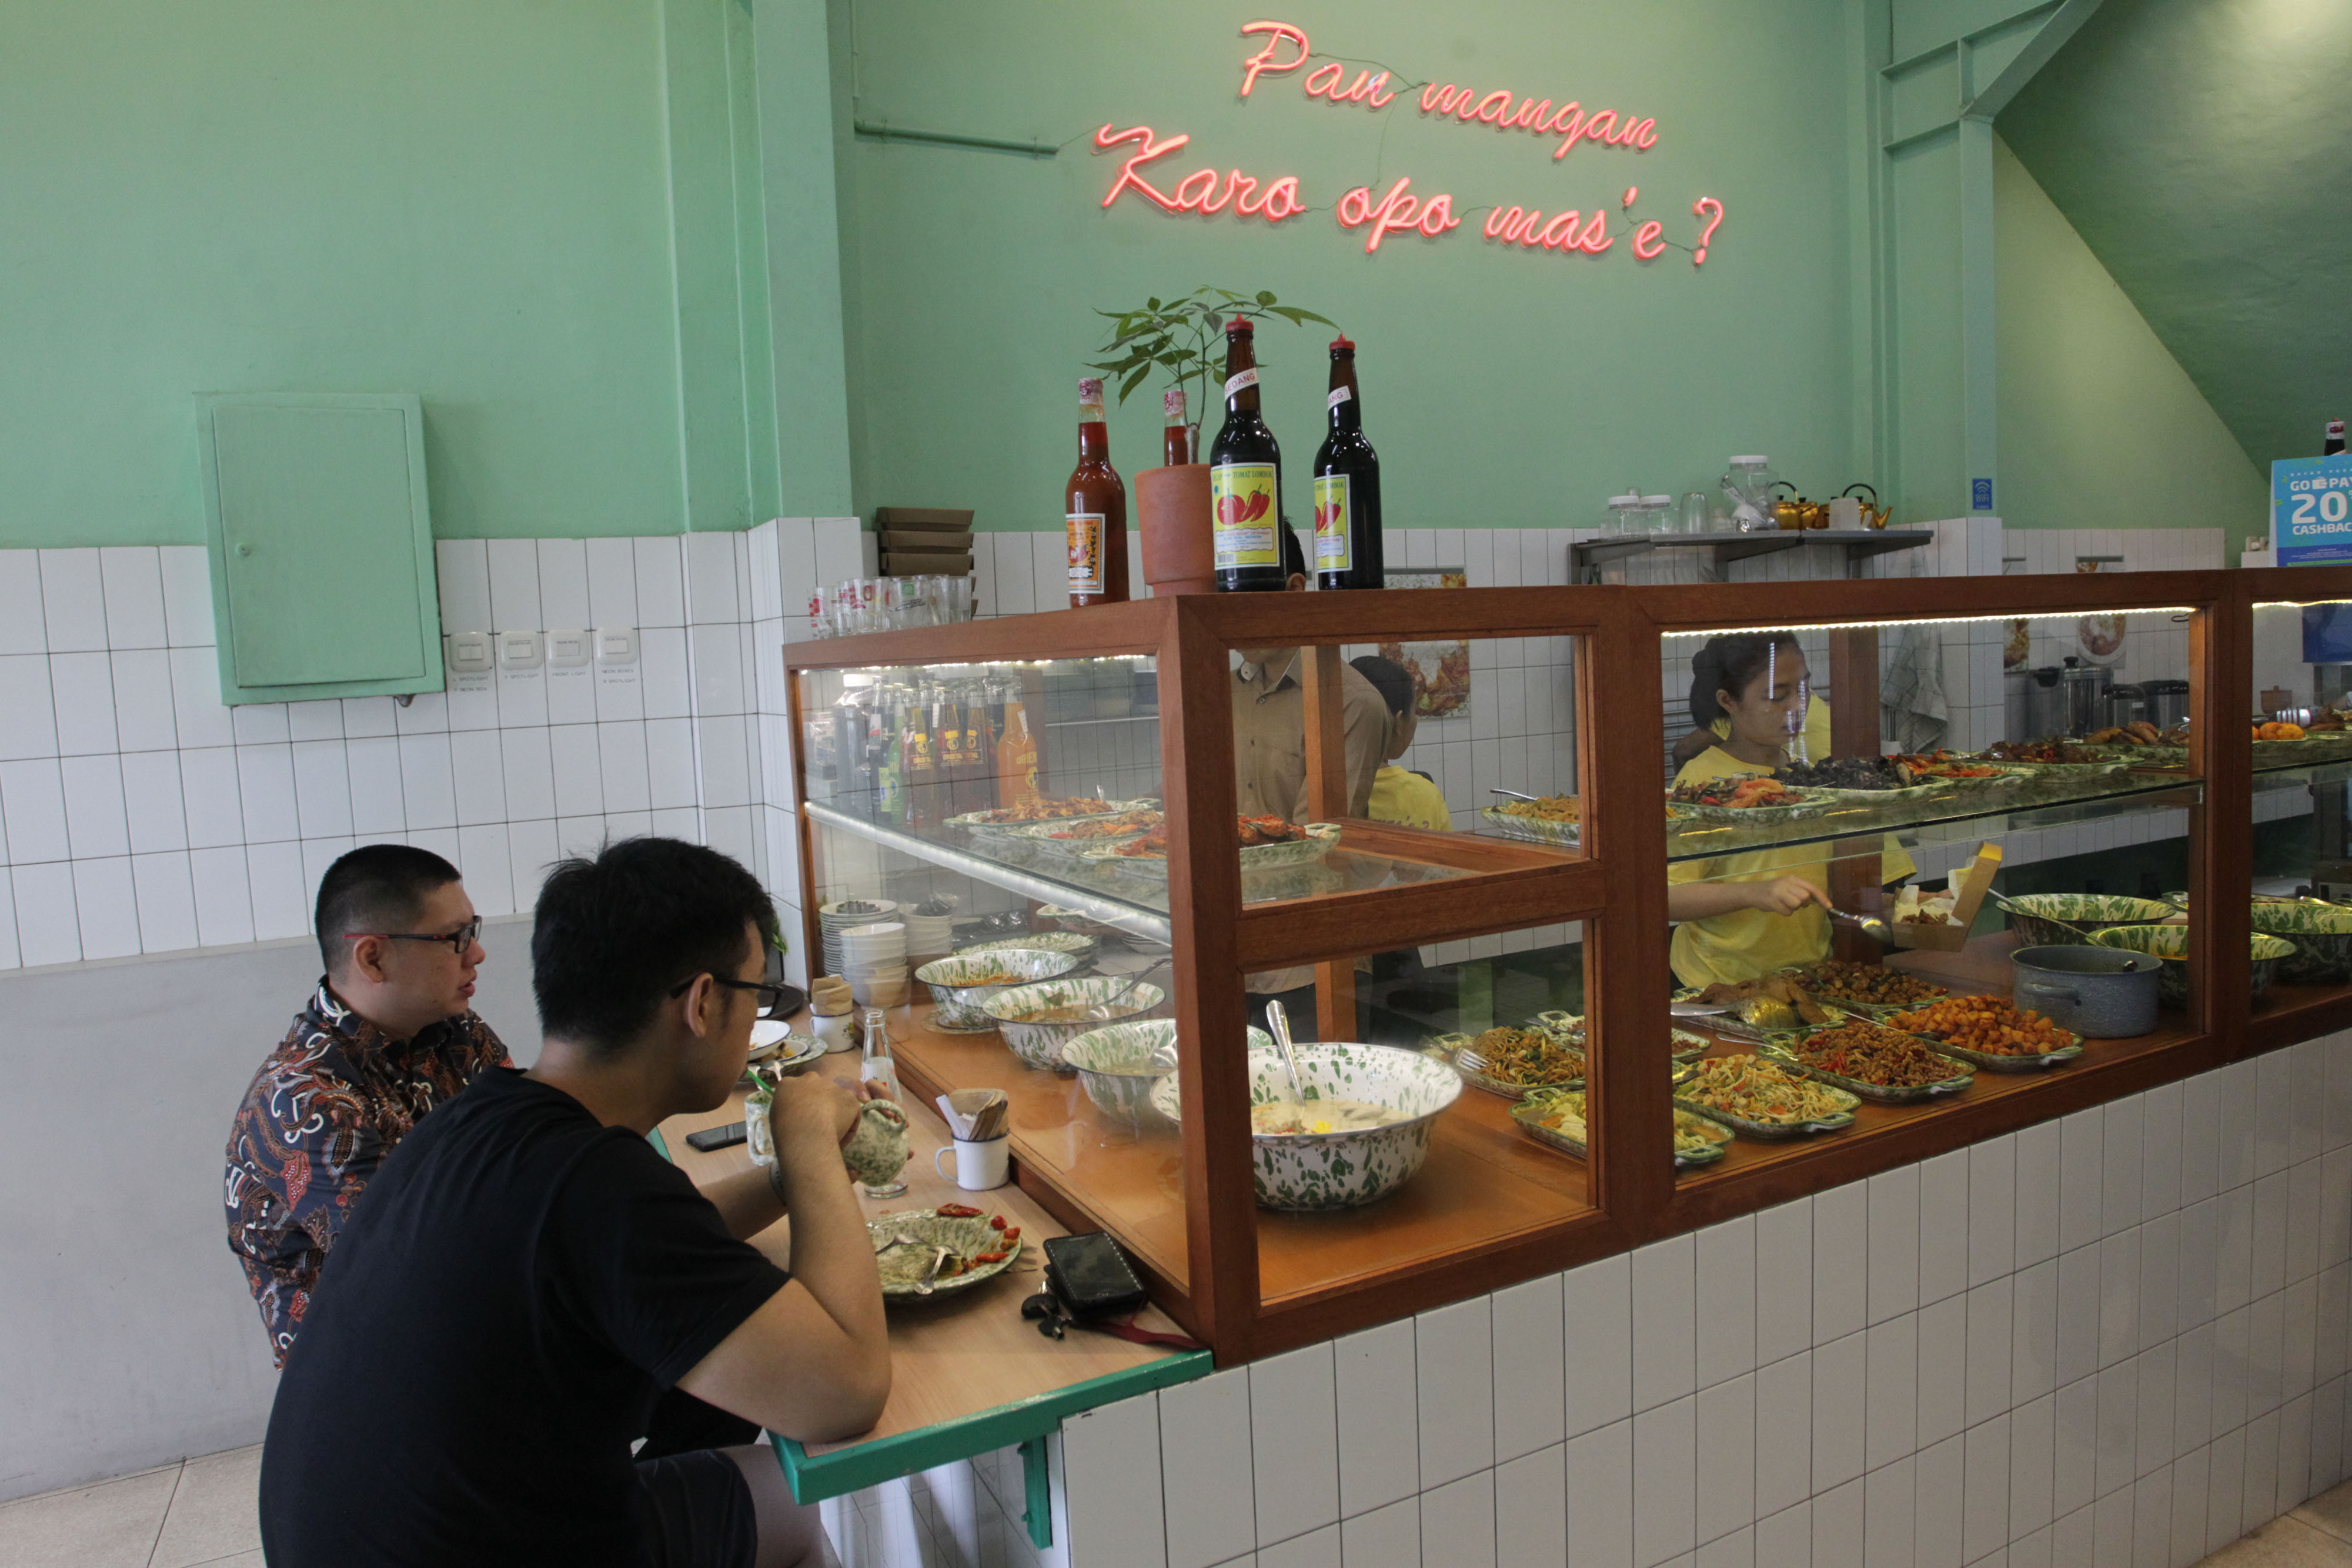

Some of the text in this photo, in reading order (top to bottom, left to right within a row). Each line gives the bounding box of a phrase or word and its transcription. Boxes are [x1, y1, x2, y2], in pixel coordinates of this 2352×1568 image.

[1419, 82, 1658, 160] mangan
[1092, 123, 1307, 223] Karo
[1337, 177, 1461, 253] opo
[1225, 372, 1256, 394] SEDANG
[2290, 480, 2311, 492] GO
